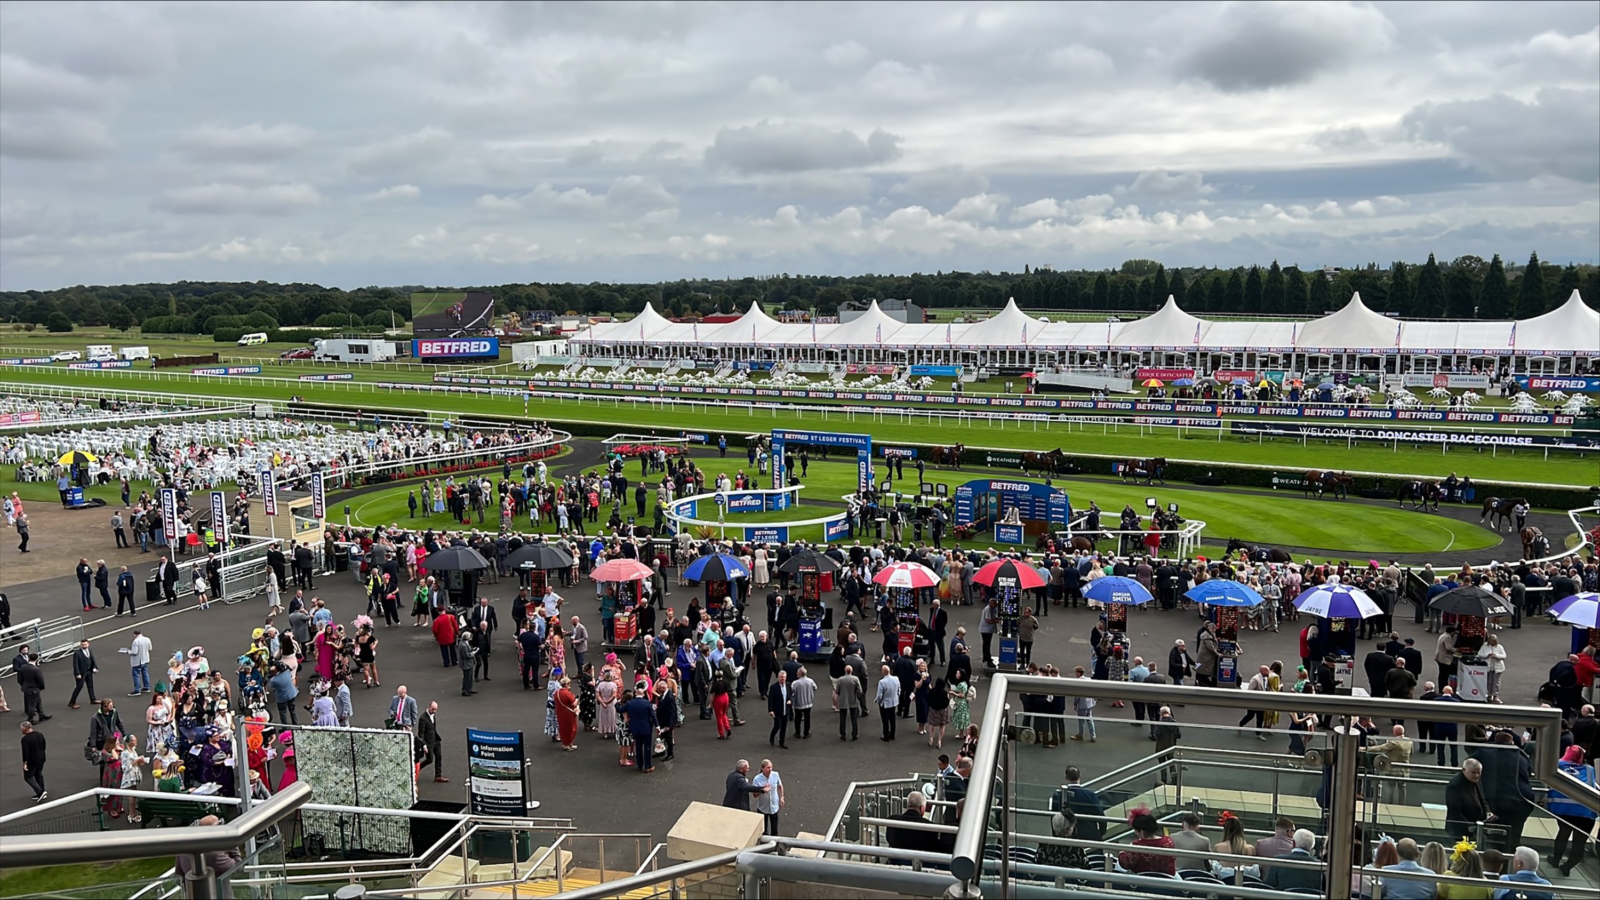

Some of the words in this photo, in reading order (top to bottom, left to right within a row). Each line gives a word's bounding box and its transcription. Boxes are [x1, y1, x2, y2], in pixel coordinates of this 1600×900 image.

[421, 341, 491, 354] BETFRED
[1532, 379, 1586, 388] BETFRED
[1259, 407, 1298, 415] BETFRED
[1304, 408, 1345, 417] BETFRED
[1350, 409, 1392, 418] BETFRED
[1398, 411, 1442, 420] BETFRED
[1448, 413, 1494, 421] BETFRED
[1501, 414, 1548, 423] BETFRED
[1300, 427, 1356, 438] WELCOME
[1359, 429, 1375, 438] TO
[1378, 430, 1447, 442] DONCASTER
[1451, 434, 1532, 444] RACECOURSE
[263, 473, 274, 512] BETFRED
[991, 482, 1029, 491] BETFRED
[312, 475, 323, 516] BETFRED
[163, 492, 174, 536] BETFRED
[214, 494, 224, 540] BETFRED
[1305, 606, 1322, 614] JAYNE
